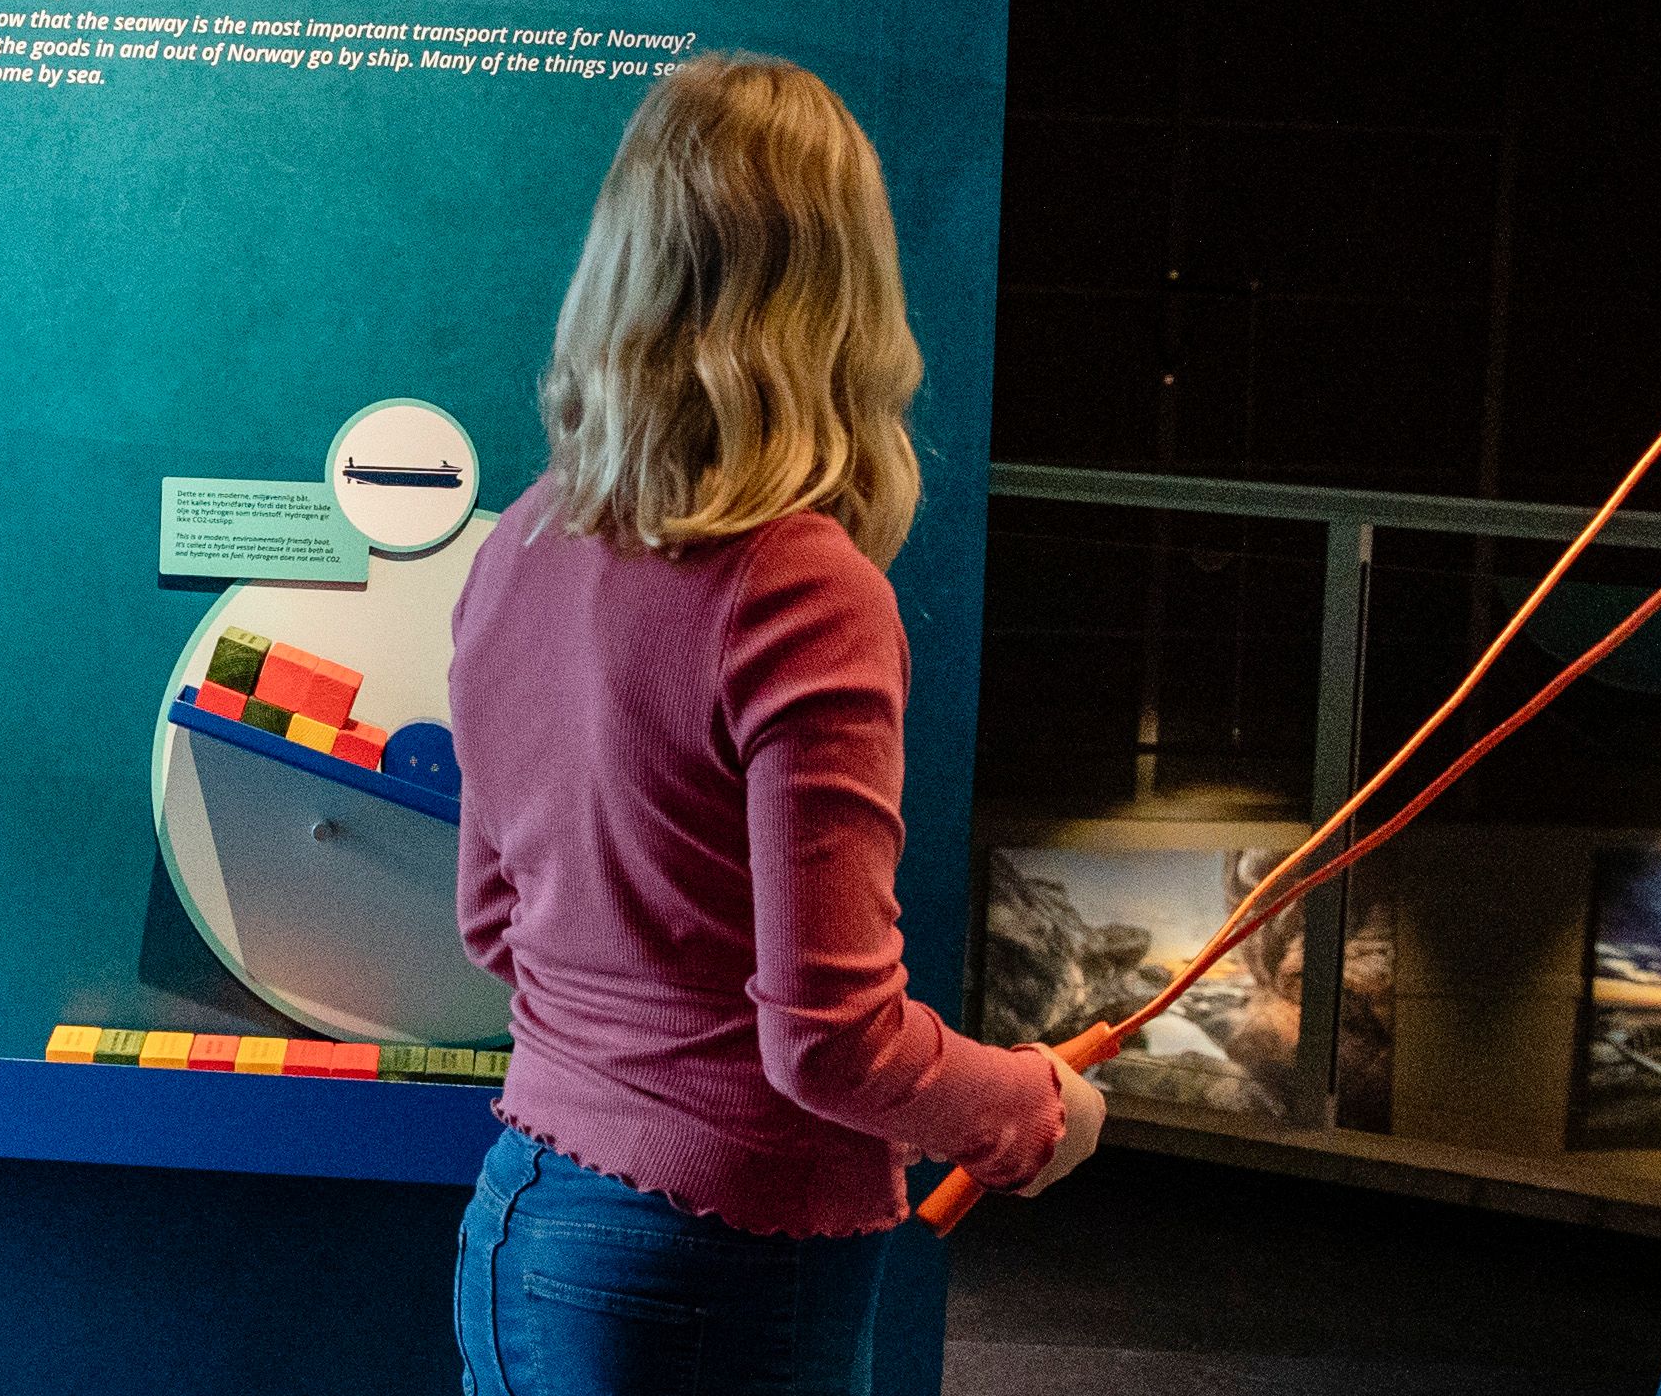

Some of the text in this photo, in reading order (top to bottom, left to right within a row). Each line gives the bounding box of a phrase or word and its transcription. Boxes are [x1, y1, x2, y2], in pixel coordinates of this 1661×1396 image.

[29, 9, 74, 31] that
[75, 10, 111, 32] the
[112, 15, 190, 38] seaway
[191, 14, 210, 35] is
[212, 15, 248, 36] the
[249, 19, 303, 38] most
[304, 17, 410, 43] important
[411, 23, 510, 48] transport
[511, 28, 569, 46] route
[568, 26, 604, 52] for
[606, 28, 697, 56] Norway?
[28, 37, 91, 61] goods
[94, 38, 116, 59] in
[118, 39, 161, 60] and
[162, 43, 199, 62] out
[200, 41, 226, 68] of
[226, 42, 307, 70] Norway
[305, 49, 335, 71] go
[337, 45, 365, 72] by
[366, 47, 414, 73] ship.
[419, 49, 479, 75] Many
[479, 50, 506, 77] of
[505, 52, 541, 73] the
[543, 54, 607, 80] things
[608, 60, 649, 80] you
[36, 63, 65, 89] by
[65, 68, 106, 86] sea.
